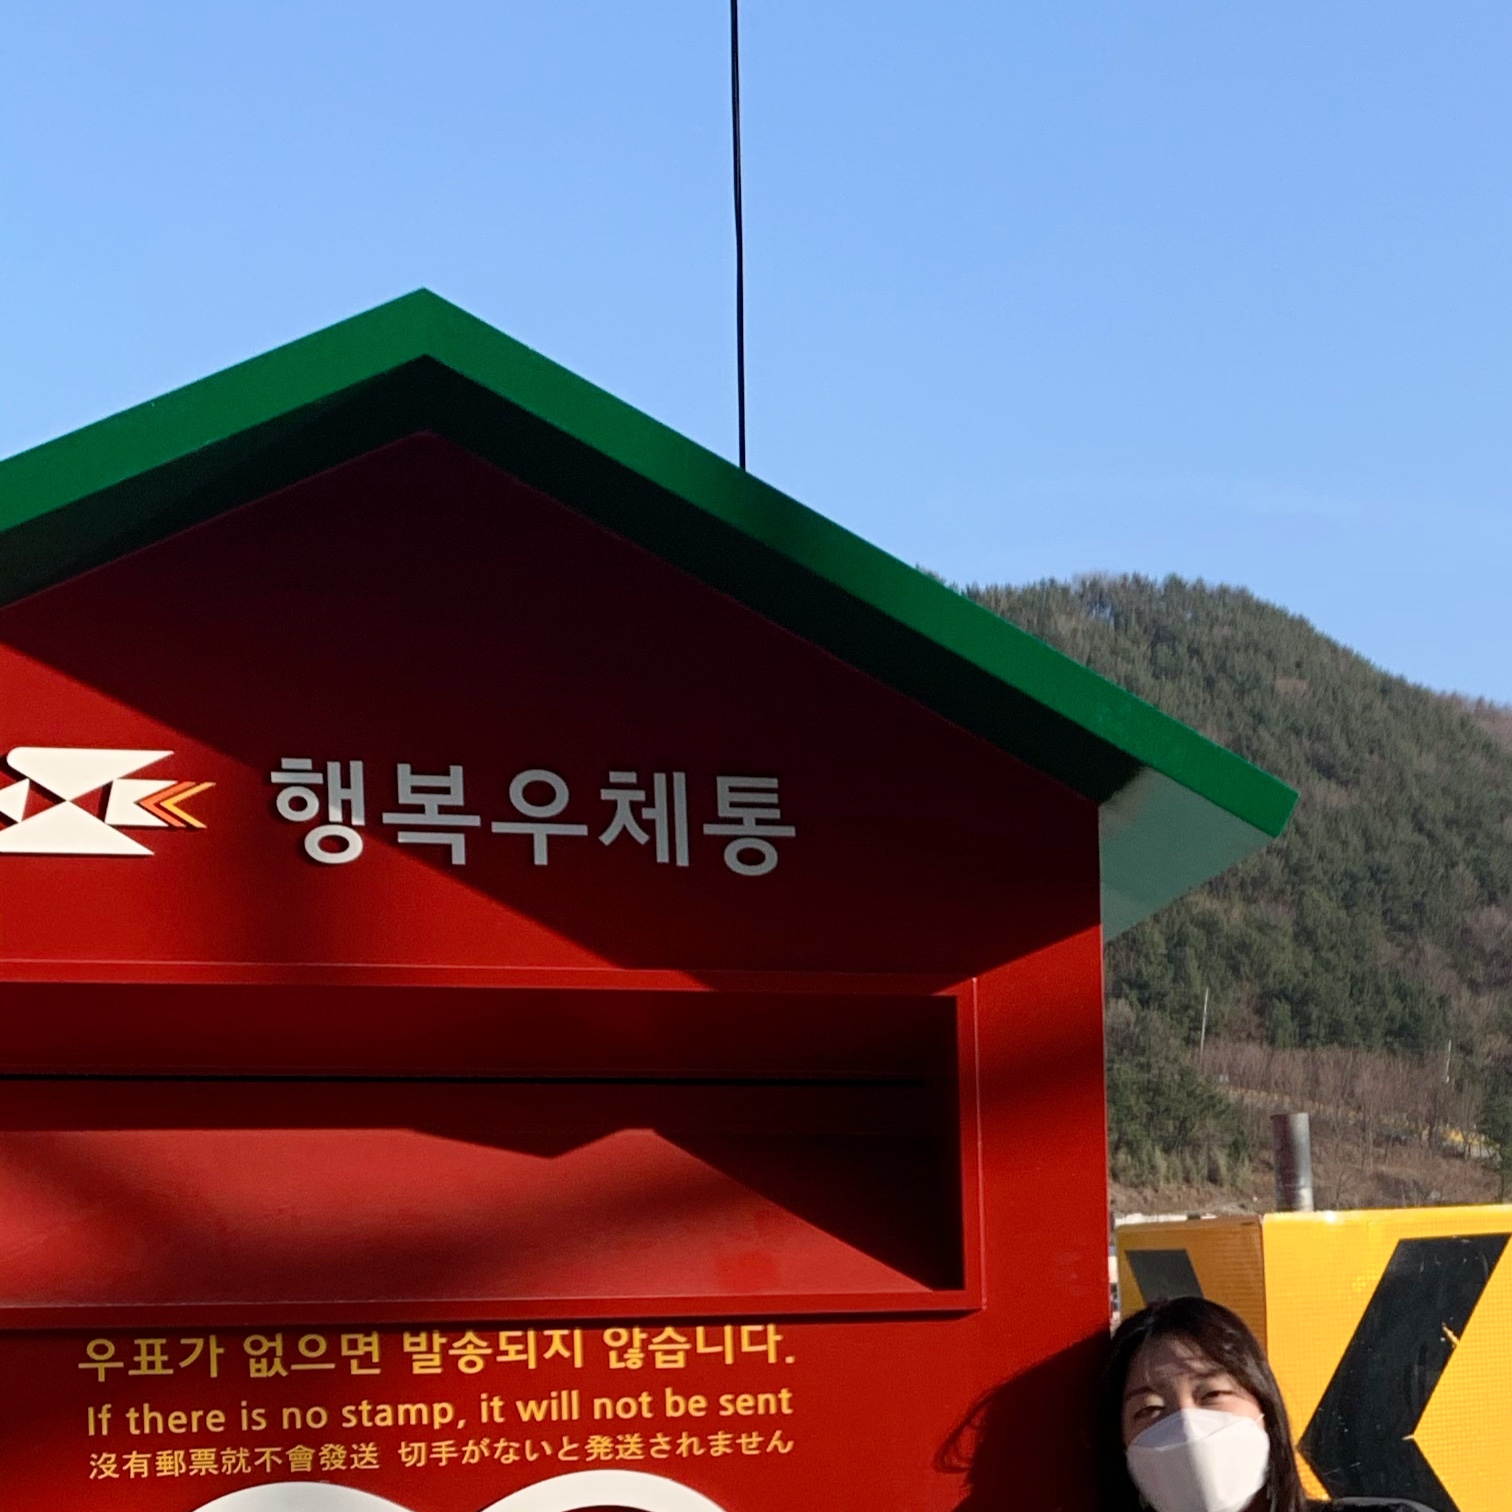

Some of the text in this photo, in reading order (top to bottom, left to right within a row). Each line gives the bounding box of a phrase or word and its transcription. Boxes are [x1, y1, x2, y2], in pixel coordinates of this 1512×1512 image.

[270, 757, 796, 876] 행복우체통
[77, 1323, 795, 1383] 우표가 없으면 발송되지 않습니다.
[87, 1386, 793, 1436] If there is no stamp, it will not be sent
[397, 1429, 794, 1468] 切手がないと発送されません
